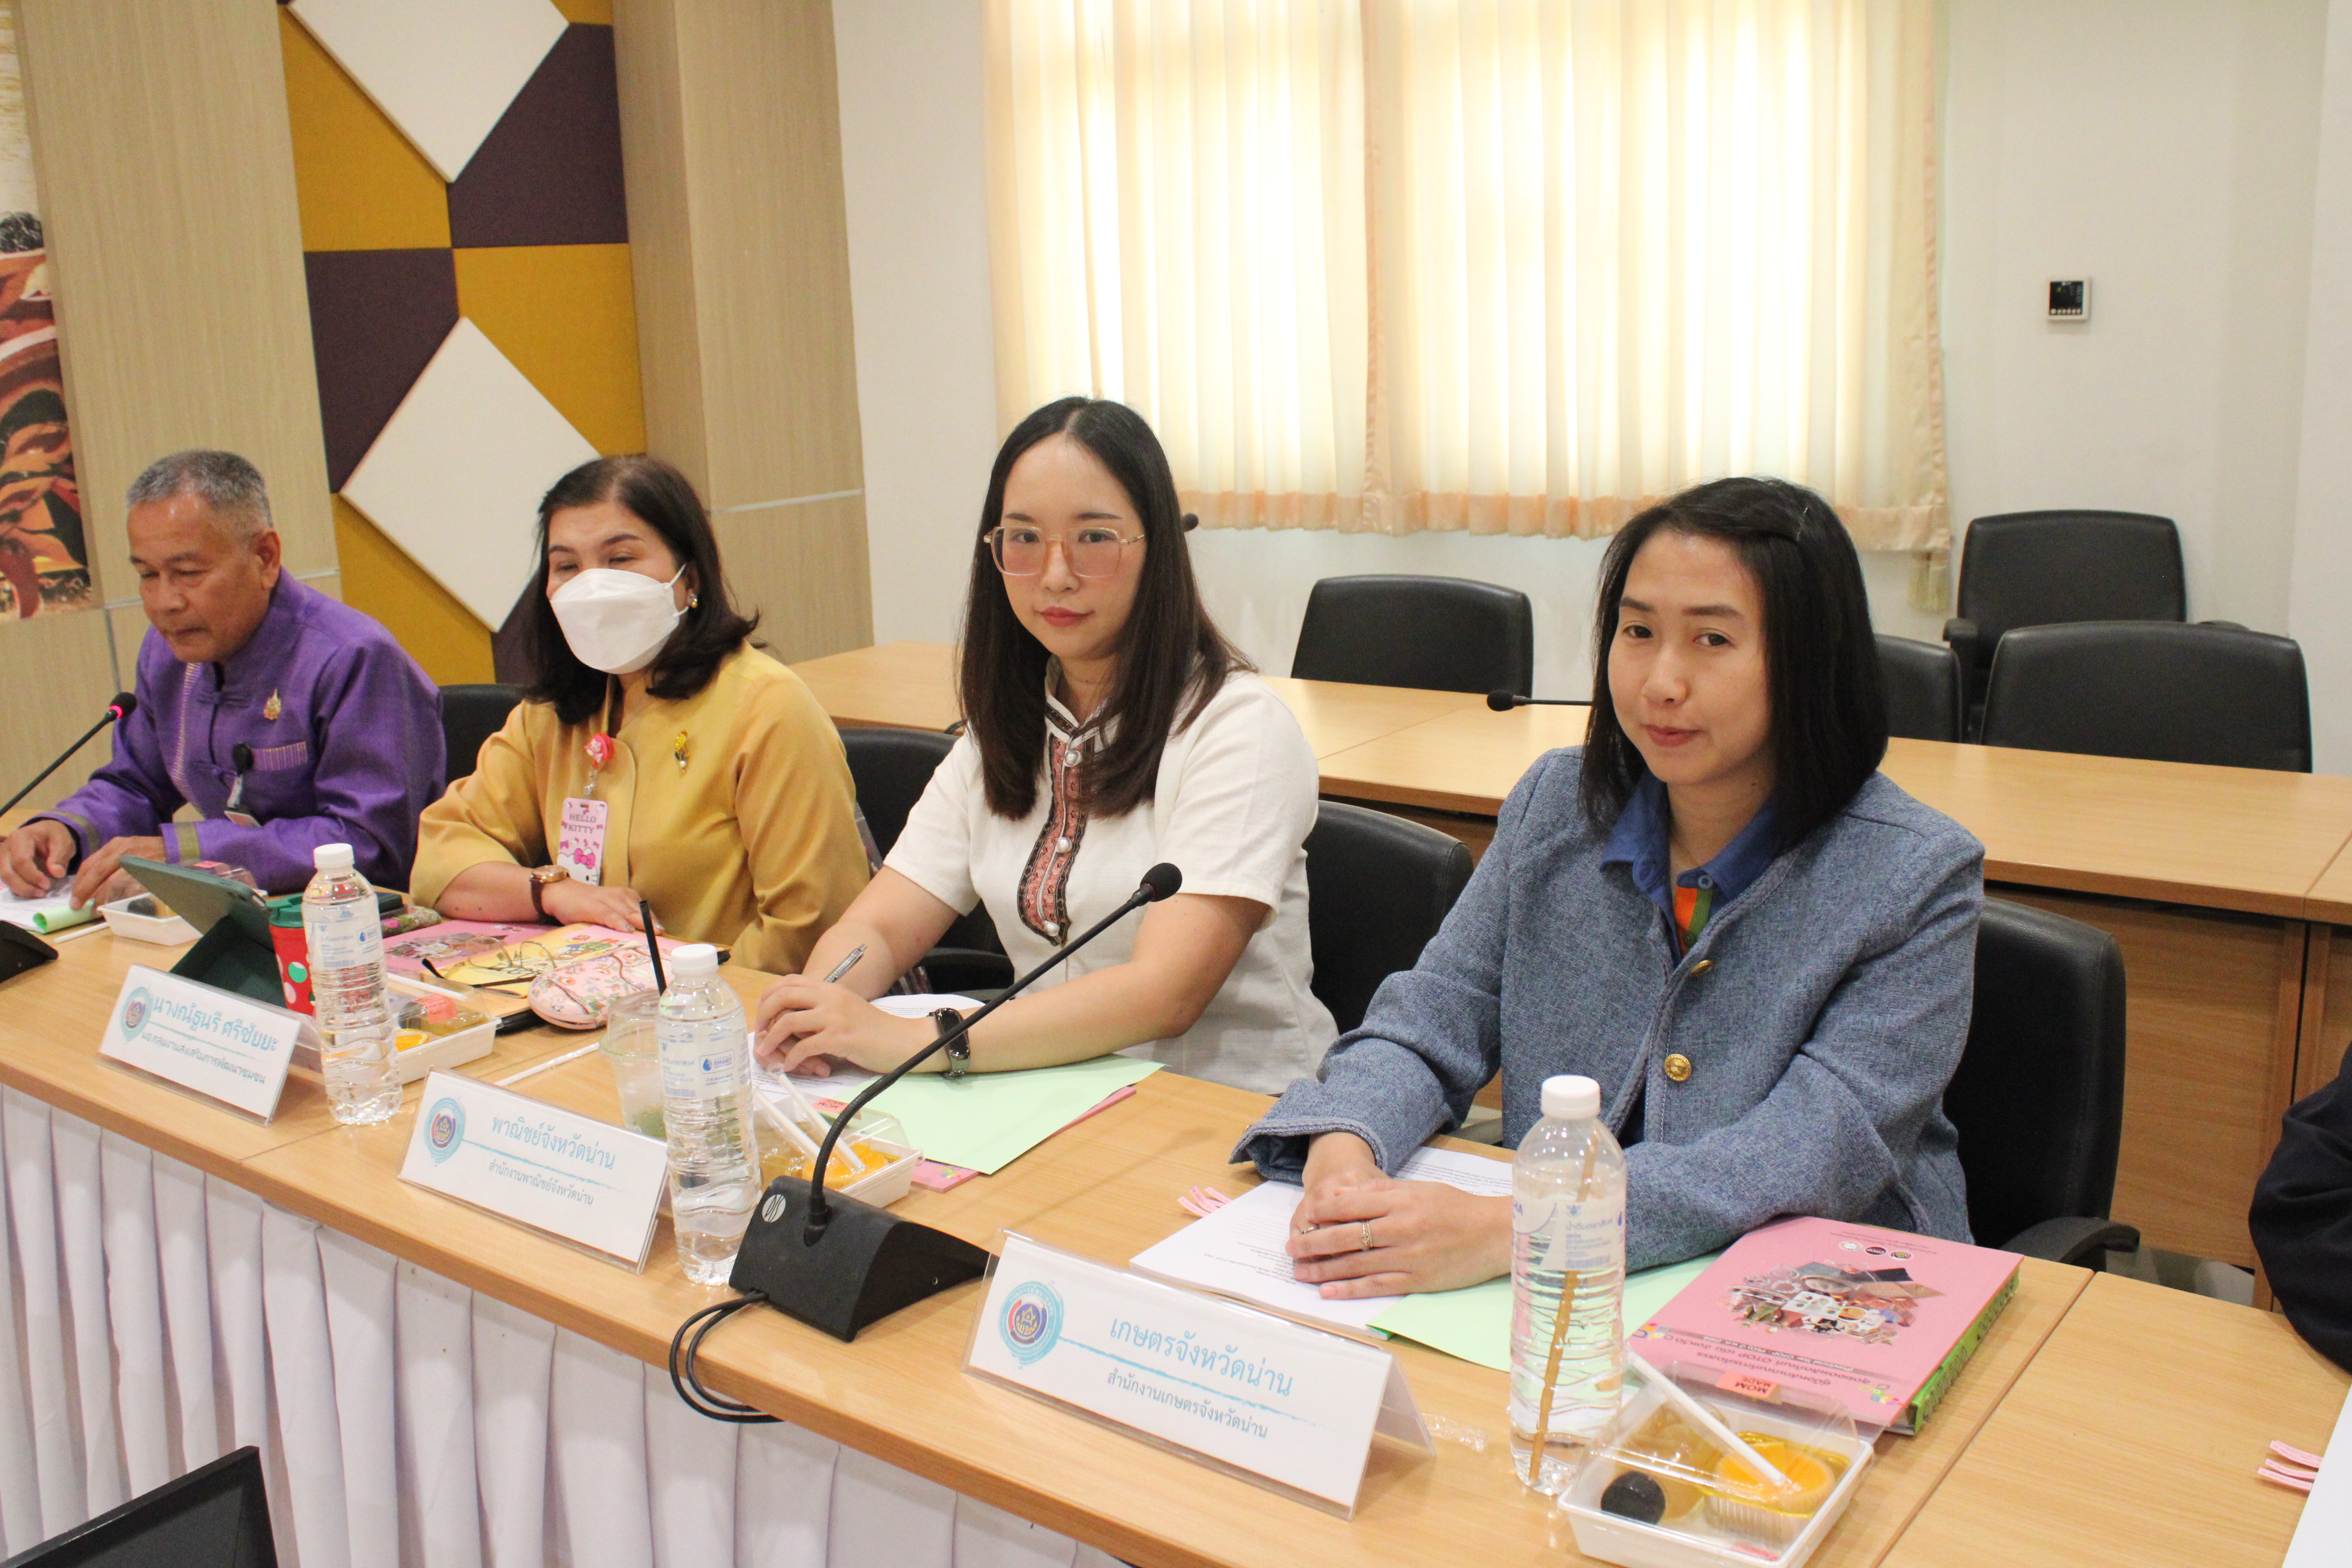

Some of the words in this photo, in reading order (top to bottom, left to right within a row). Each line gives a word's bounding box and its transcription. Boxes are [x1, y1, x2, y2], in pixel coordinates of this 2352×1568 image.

[569, 814, 596, 823] HELLO
[568, 824, 594, 834] KITTY
[714, 1057, 732, 1066] SMART
[491, 1116, 615, 1170] พาณิชย์จังหวัดน่าน
[489, 1159, 594, 1206] สำนักงานพาณิชย์จังหวัดน่าน
[1110, 1317, 1296, 1397] เกษตรจังหวัดน่าน
[1738, 1353, 1772, 1364] OTOP
[1772, 1351, 1795, 1360] OTOP
[1812, 1359, 1854, 1372] (Provincial
[1735, 1381, 1768, 1394] MOM
[1106, 1368, 1268, 1439] สำนักงานเกษตรจังหวัดน่าน
